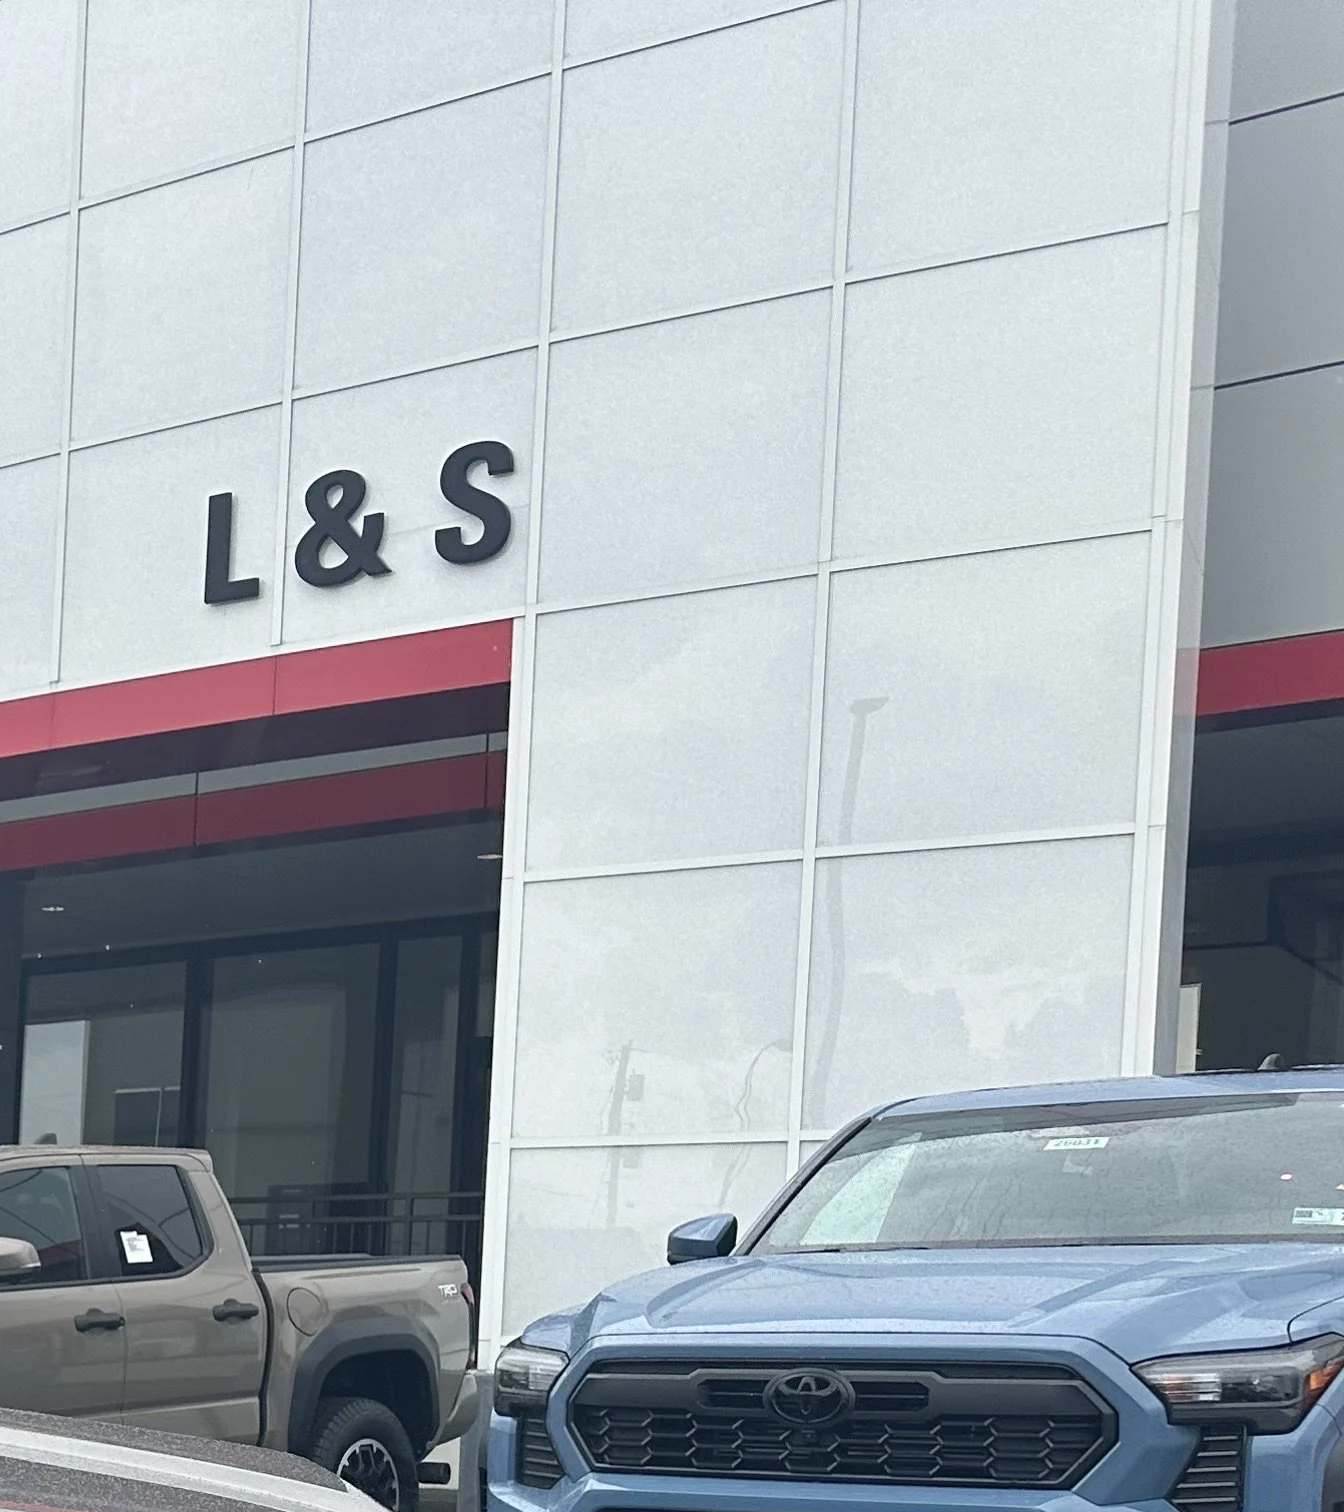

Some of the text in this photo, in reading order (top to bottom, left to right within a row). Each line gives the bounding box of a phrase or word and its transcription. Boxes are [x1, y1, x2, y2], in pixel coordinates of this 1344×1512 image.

[204, 440, 514, 604] L & S
[438, 1284, 458, 1297] TRD
